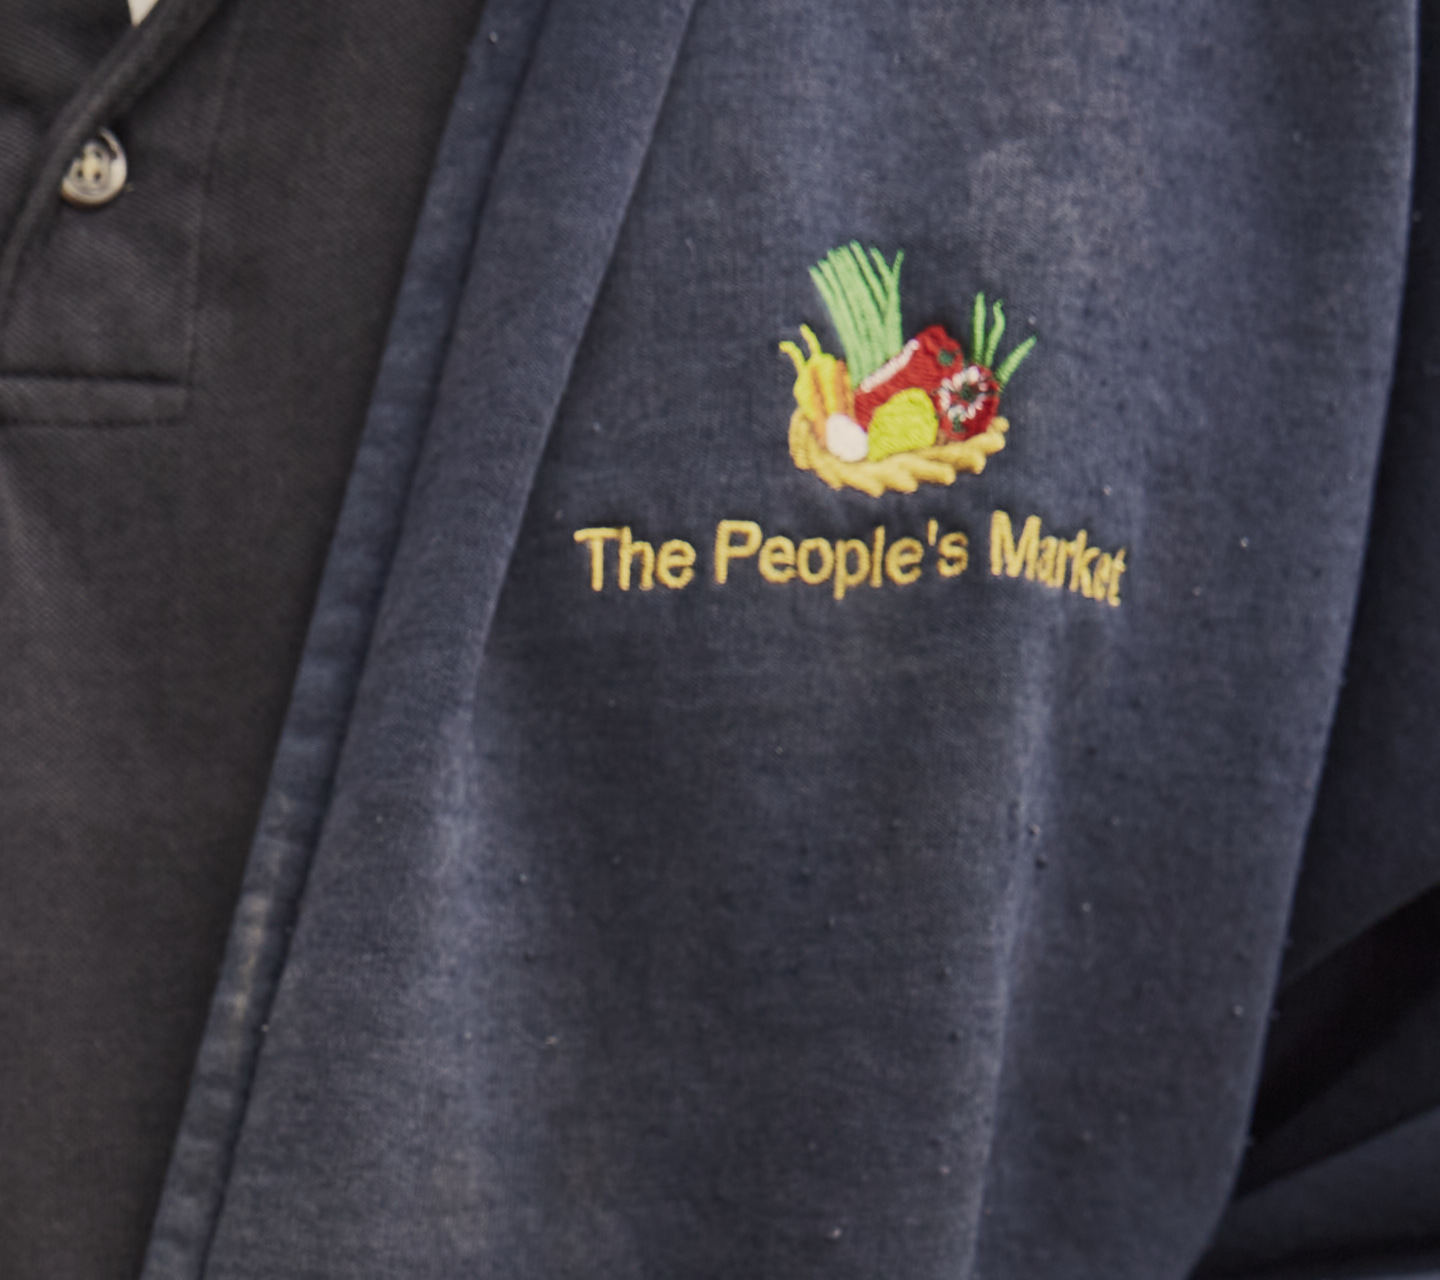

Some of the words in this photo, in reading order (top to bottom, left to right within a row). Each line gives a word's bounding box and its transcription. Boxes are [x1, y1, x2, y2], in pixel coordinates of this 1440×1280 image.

[573, 525, 697, 593] The
[713, 519, 969, 601] People's
[989, 510, 1128, 608] Market
